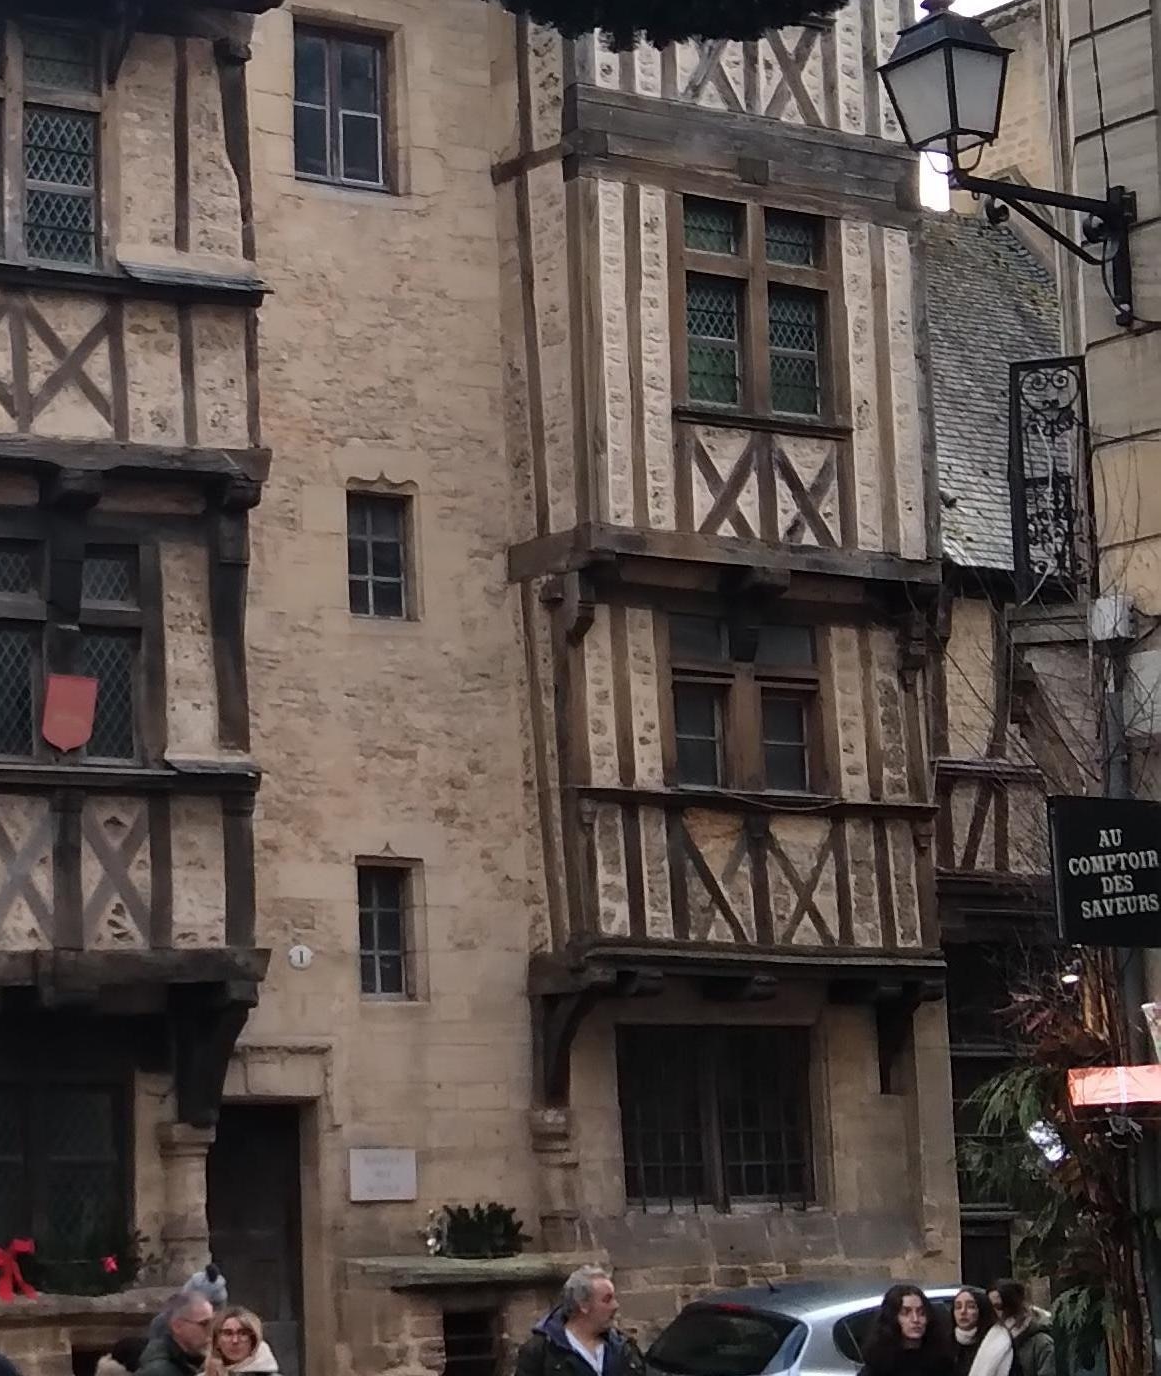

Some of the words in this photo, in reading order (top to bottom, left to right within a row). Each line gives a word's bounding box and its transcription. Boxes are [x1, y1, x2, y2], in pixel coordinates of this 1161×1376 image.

[1099, 828, 1122, 848] AU
[1068, 850, 1159, 876] COMPTOIR
[1100, 874, 1134, 895] DES
[1080, 893, 1160, 919] SAVEURS
[299, 950, 304, 964] 1
